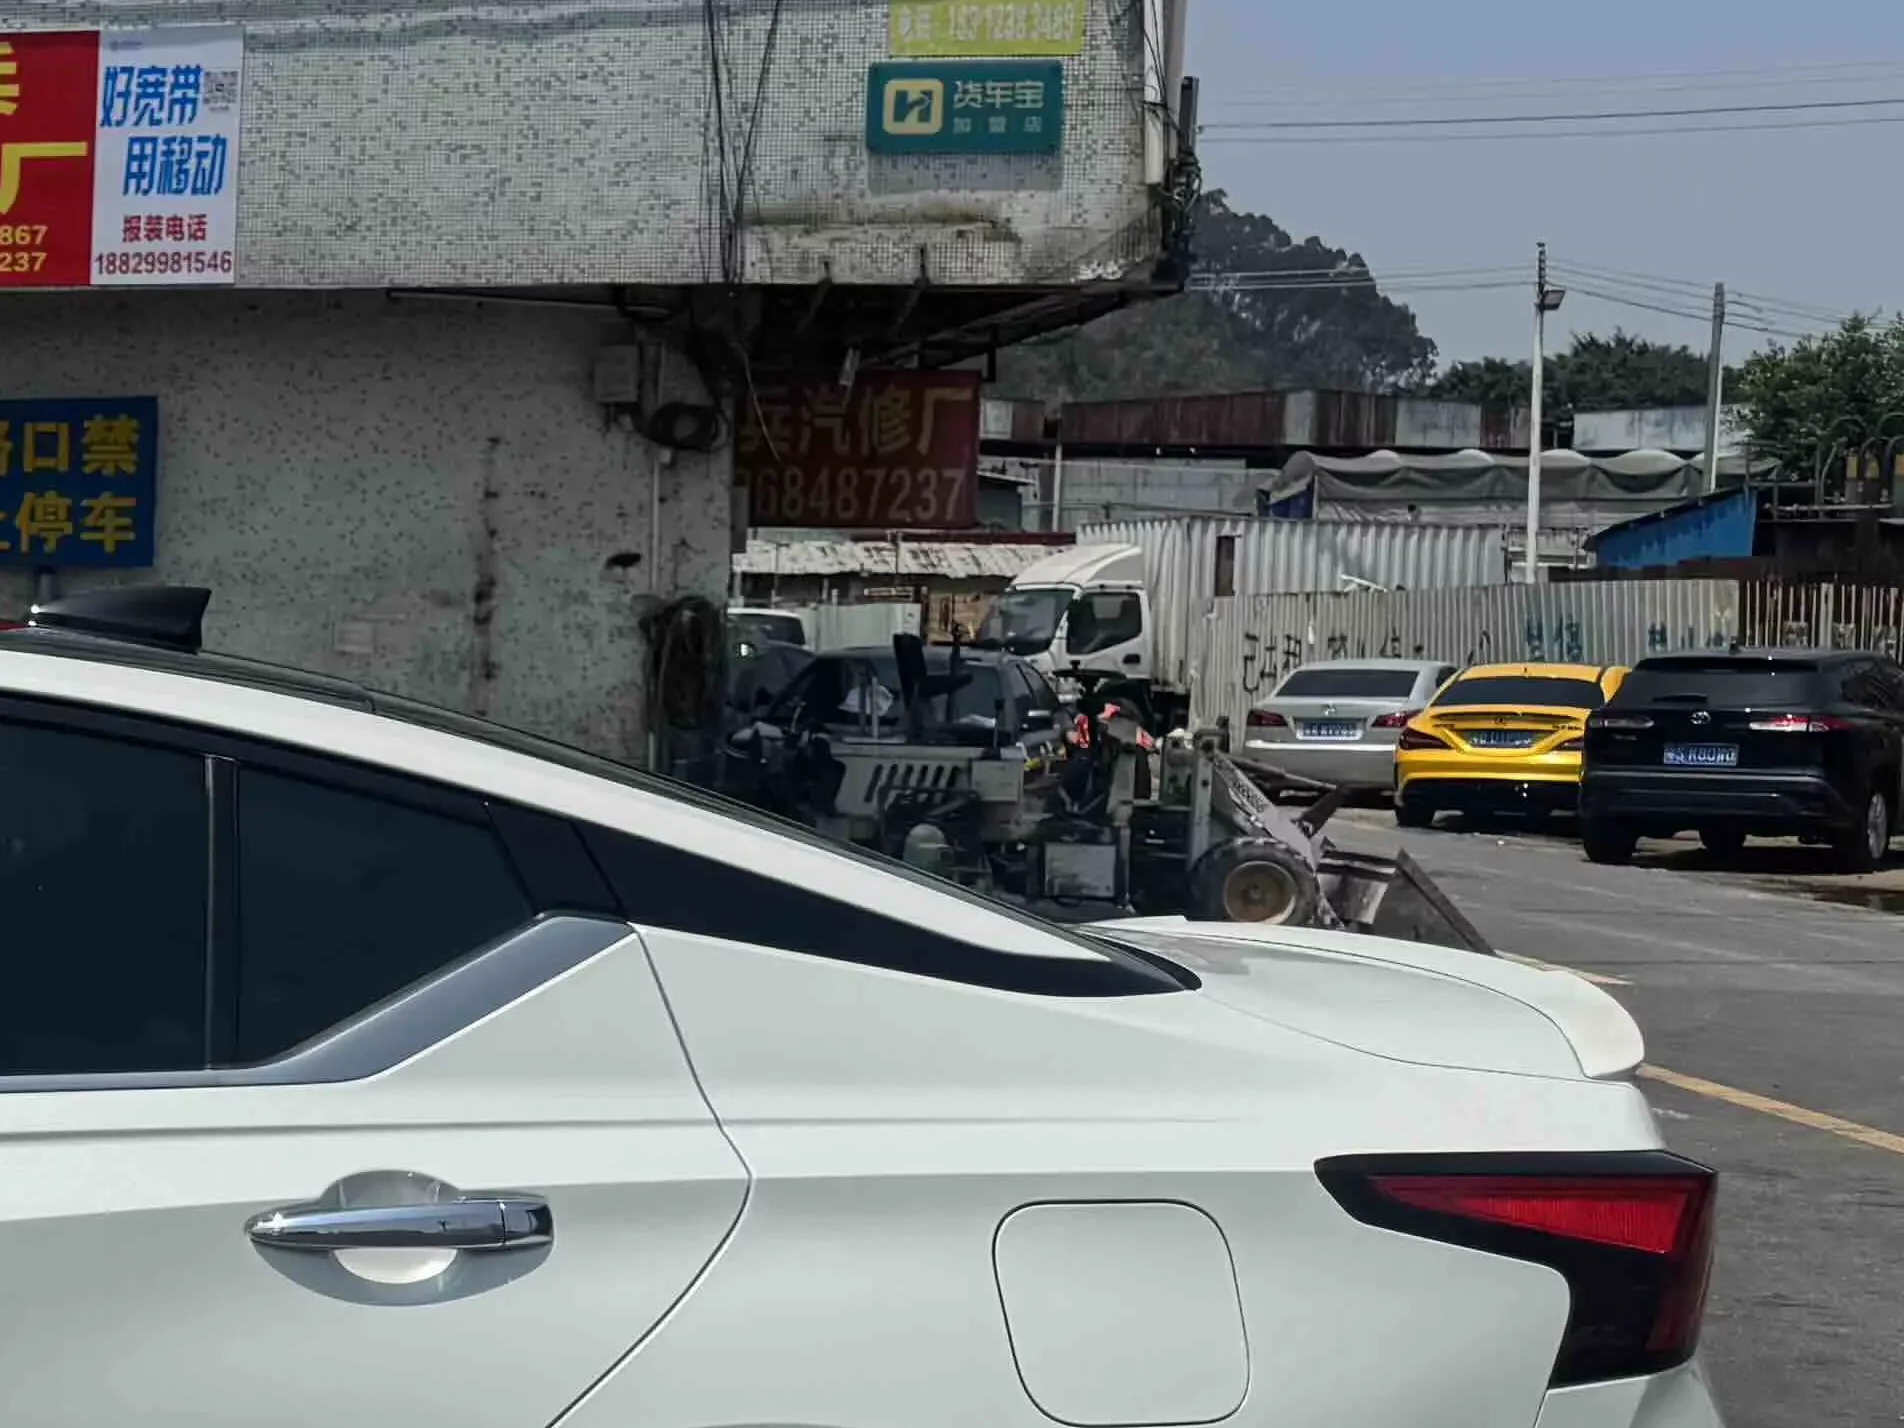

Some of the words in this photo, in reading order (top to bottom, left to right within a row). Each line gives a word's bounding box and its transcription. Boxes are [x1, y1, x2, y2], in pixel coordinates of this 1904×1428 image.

[99, 64, 203, 127] 好宽带
[953, 80, 1044, 109] 货车宝
[123, 134, 229, 197] 用移动
[122, 214, 208, 243] 报装电话
[95, 250, 233, 275] 18829981546
